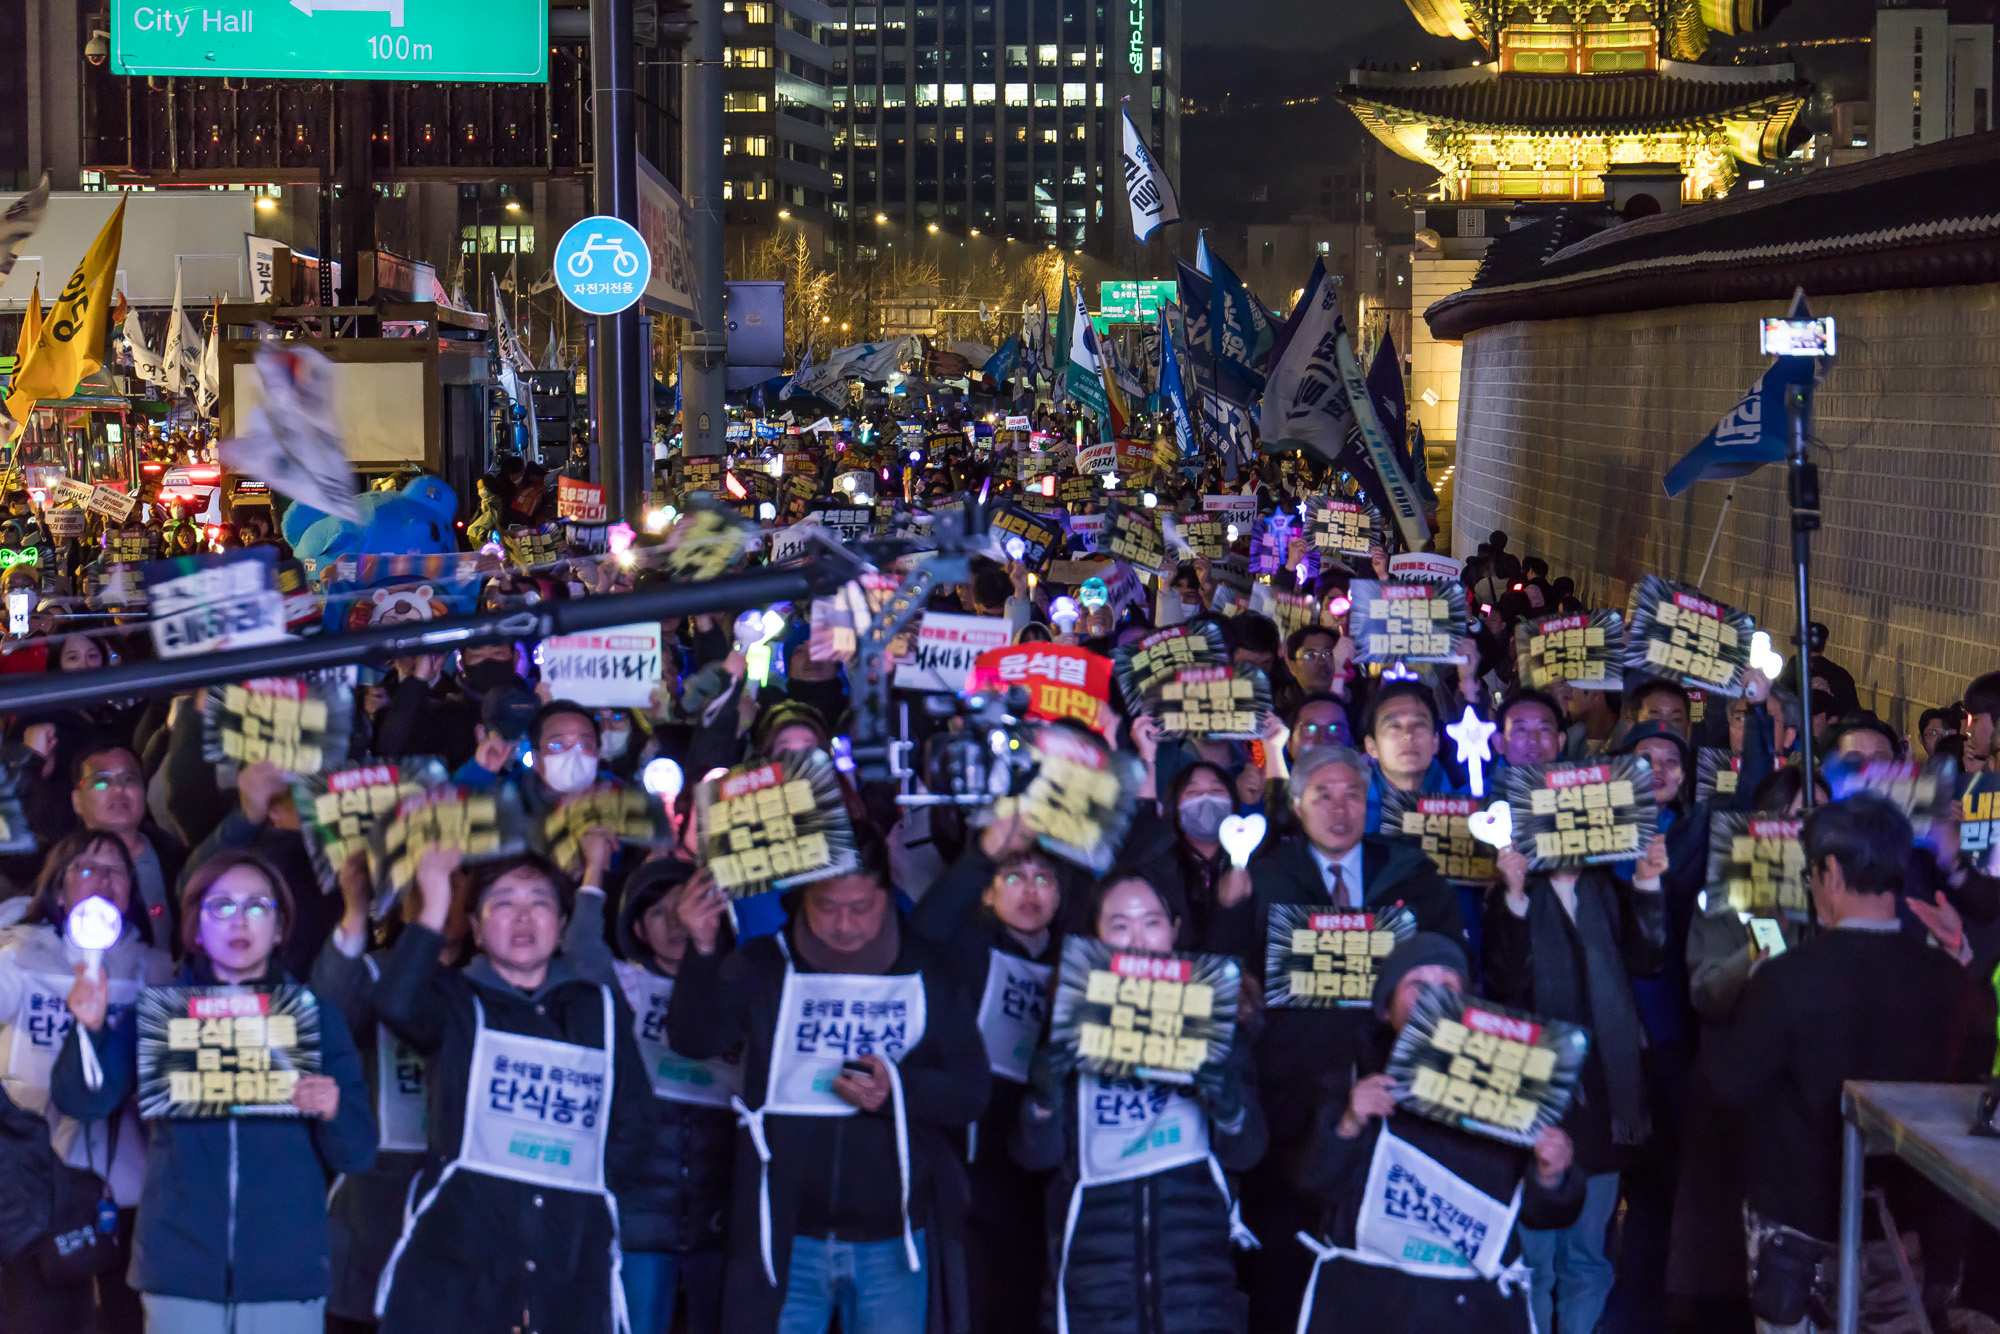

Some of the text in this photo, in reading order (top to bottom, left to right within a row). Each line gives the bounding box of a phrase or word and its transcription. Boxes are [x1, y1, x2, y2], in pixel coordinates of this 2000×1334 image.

[134, 8, 253, 37] City Hall
[368, 34, 433, 60] 100m
[573, 282, 634, 294] 자전거전용
[167, 478, 189, 486] TAXI
[993, 511, 1028, 535] 내란
[1026, 524, 1053, 547] 종식
[1175, 522, 1222, 537] 윤석열을
[1229, 511, 1256, 523] 하라!
[1316, 508, 1370, 528] 윤석열을
[1315, 532, 1369, 550] 파면하라
[1369, 599, 1450, 619] 윤석열을
[1656, 602, 1738, 647] 윤석열을
[1369, 633, 1451, 654] 파면하라
[1529, 628, 1605, 655] 윤석열을
[1000, 653, 1087, 687] 윤석열
[1646, 639, 1735, 684] 파면하라
[1162, 679, 1253, 700] 윤석열을
[1164, 711, 1257, 731] 파면하라
[708, 779, 816, 834] 윤석열을
[1531, 780, 1635, 814] 윤석열을
[1963, 792, 2000, 821] 내
[1402, 811, 1471, 837] 윤석열
[1960, 821, 2000, 850] 민
[1535, 825, 1639, 858] 파면하라
[710, 832, 829, 887] 파면하라
[1292, 930, 1395, 955] 윤석열을
[29, 992, 68, 1009] 윤석
[801, 998, 845, 1018] 윤석열
[1085, 971, 1215, 1016] 윤석열을
[168, 1016, 297, 1050] 윤석열을
[796, 1020, 907, 1055] 단식농성
[1078, 1023, 1208, 1071] 파면하라
[1432, 1018, 1557, 1081] 윤석열을
[493, 1055, 543, 1082] 윤석열
[169, 1071, 296, 1103] 파면하라
[1410, 1066, 1539, 1130] 파면하라
[489, 1078, 600, 1128] 단식농성
